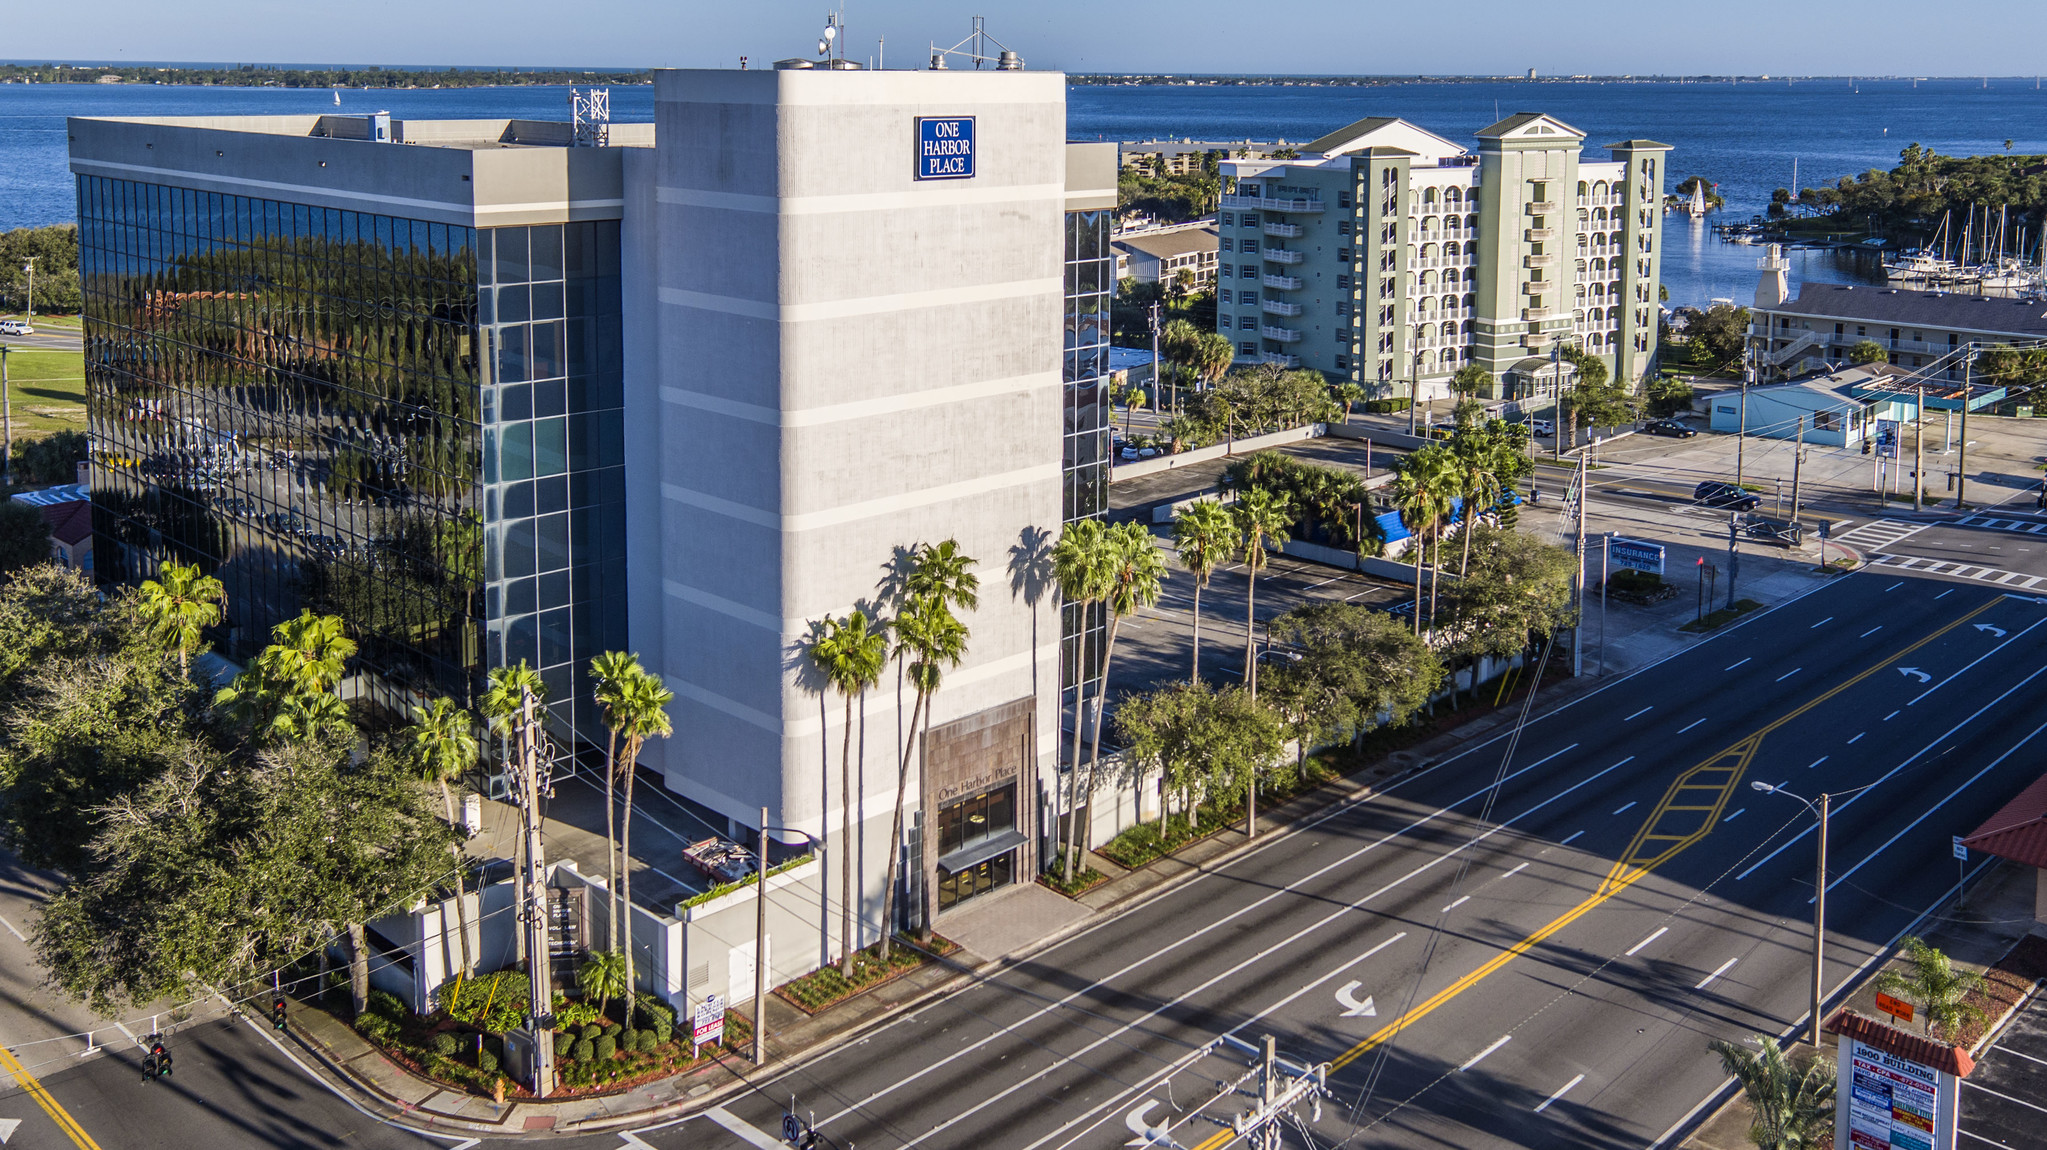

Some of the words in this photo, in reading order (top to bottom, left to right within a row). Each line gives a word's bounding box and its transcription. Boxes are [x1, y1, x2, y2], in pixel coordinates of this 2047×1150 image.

[935, 122, 960, 138] ONE
[924, 140, 970, 156] HARBOR
[930, 158, 964, 174] PLACE
[1612, 546, 1660, 561] INSURANCE
[938, 788, 958, 800] One
[961, 775, 991, 792] Harbor
[996, 766, 1016, 779] Place
[696, 1026, 708, 1036] FOR
[708, 1020, 724, 1032] LEASE
[1856, 1046, 1880, 1060] 1900
[1883, 1056, 1934, 1080] BUILDING
[1858, 1060, 1871, 1070] TAX
[1876, 1068, 1891, 1078] CPA
[1854, 1066, 1870, 1077] DAVID
